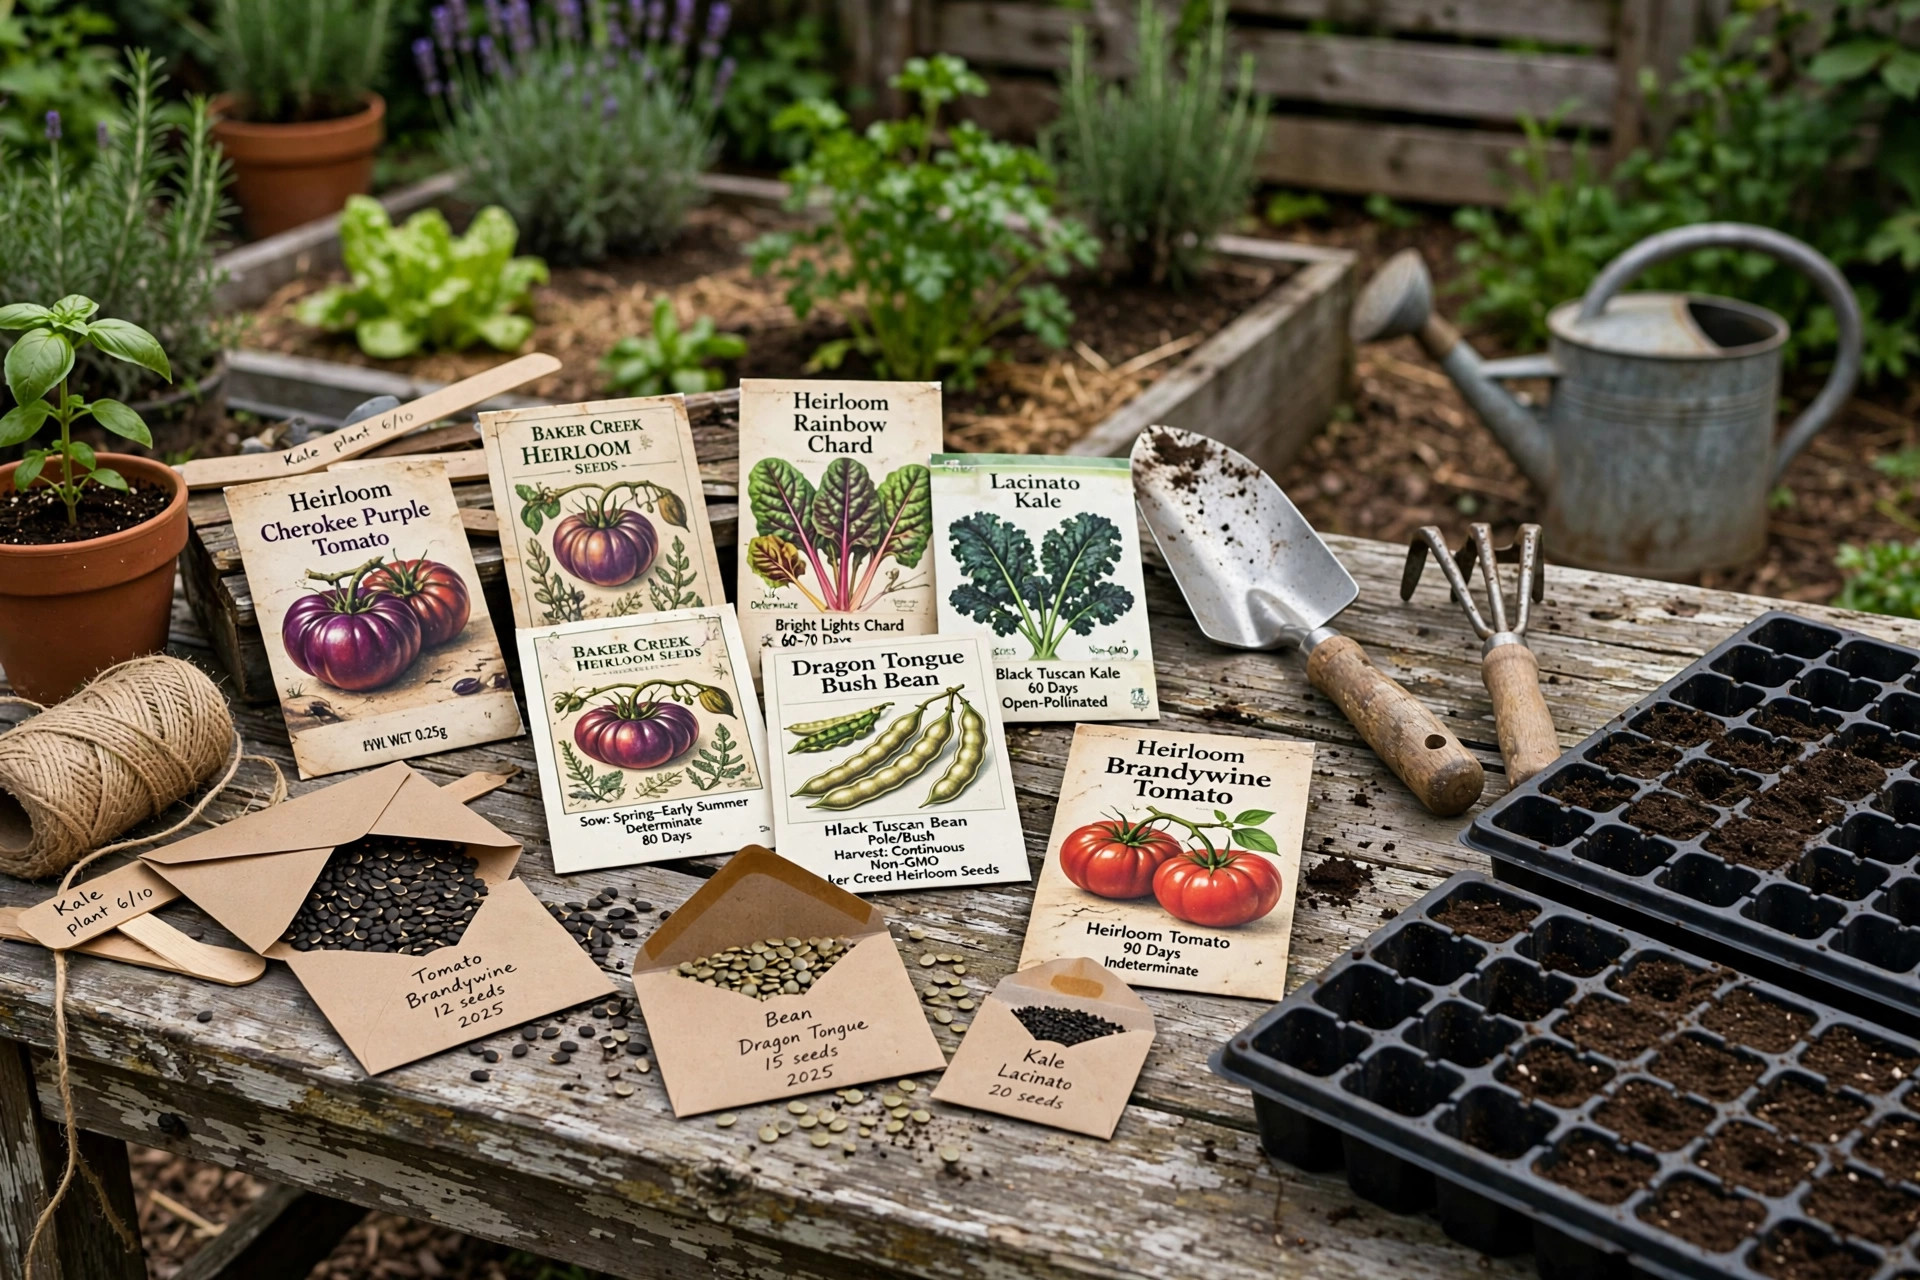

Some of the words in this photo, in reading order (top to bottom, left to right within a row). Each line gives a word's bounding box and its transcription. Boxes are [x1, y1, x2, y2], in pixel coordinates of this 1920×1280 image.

[794, 392, 889, 411] Heirloom
[531, 424, 586, 442] BAKER
[590, 418, 644, 435] CREEK
[794, 413, 887, 432] Rainbow
[283, 448, 320, 466] Kale
[333, 426, 370, 452] plant
[381, 413, 414, 430] 6/10
[807, 435, 873, 453] Chard
[521, 440, 632, 466] HEIRLOOM
[575, 461, 618, 474] SEEDS
[989, 473, 1080, 490] Lacinato
[288, 484, 392, 512] Heirloom
[1014, 492, 1062, 508] Kale
[261, 515, 358, 542] Cherokee
[361, 499, 431, 526] Purple
[312, 533, 389, 556] Tomato
[775, 618, 817, 634] Bright
[821, 618, 860, 634] Lights
[864, 619, 904, 631] Chard
[571, 643, 629, 659] BAKER
[634, 636, 692, 652] CREEK
[576, 654, 655, 671] HEIRLOOM
[659, 647, 702, 661] SEEDS
[791, 658, 876, 677] Dragon
[880, 652, 965, 670] Tongue
[996, 667, 1033, 680] Black
[1037, 667, 1086, 679] Tuscan
[1090, 666, 1121, 679] Kale
[821, 673, 877, 694] Bush
[883, 672, 940, 689] Bean
[1028, 682, 1044, 693] 60
[1047, 682, 1078, 695] Days
[1002, 695, 1108, 712] Open-Pollinated
[387, 731, 412, 747] WET
[415, 725, 448, 741] 0.25g
[1136, 739, 1245, 763] Heirloom
[1105, 756, 1272, 787] Brandywine
[1133, 779, 1233, 805] Tomato
[579, 816, 610, 827] Sow:
[698, 798, 749, 812] Summer
[626, 816, 703, 834] Determinate
[873, 820, 924, 833] Tuscan
[930, 816, 968, 829] Bean
[642, 834, 658, 846] 80
[662, 831, 693, 845] Days
[867, 831, 935, 846] Pole/Bush
[834, 848, 888, 861] Harvest:
[891, 843, 965, 857] Continuous
[870, 855, 939, 870] Non-GMO
[828, 874, 850, 885] ker
[853, 870, 892, 884] Creed
[896, 868, 958, 881] Heirloom
[960, 863, 1000, 876] Seeds
[52, 891, 104, 916] Kale
[67, 905, 108, 937] plant
[117, 888, 153, 909] 6/10
[1086, 922, 1163, 942] Heirloom
[1169, 930, 1231, 949] Tomato
[1123, 942, 1142, 954] 90
[1146, 944, 1181, 961] Days
[411, 955, 482, 984] Tomato
[1104, 956, 1199, 977] Indeterminate
[405, 964, 517, 1009] Brandywine
[434, 1002, 454, 1018] 12
[460, 984, 505, 1008] seeds
[458, 1001, 503, 1028] 2025
[765, 1010, 812, 1028] Bean
[738, 1033, 800, 1056] Dragon
[807, 1020, 869, 1041] Tongue
[765, 1054, 783, 1071] 15
[794, 1044, 838, 1065] seeds
[1023, 1048, 1065, 1069] Kale
[787, 1064, 834, 1087] 2025
[998, 1063, 1072, 1090] Lacinato
[988, 1084, 1012, 1098] 20
[1017, 1095, 1064, 1110] seeds
